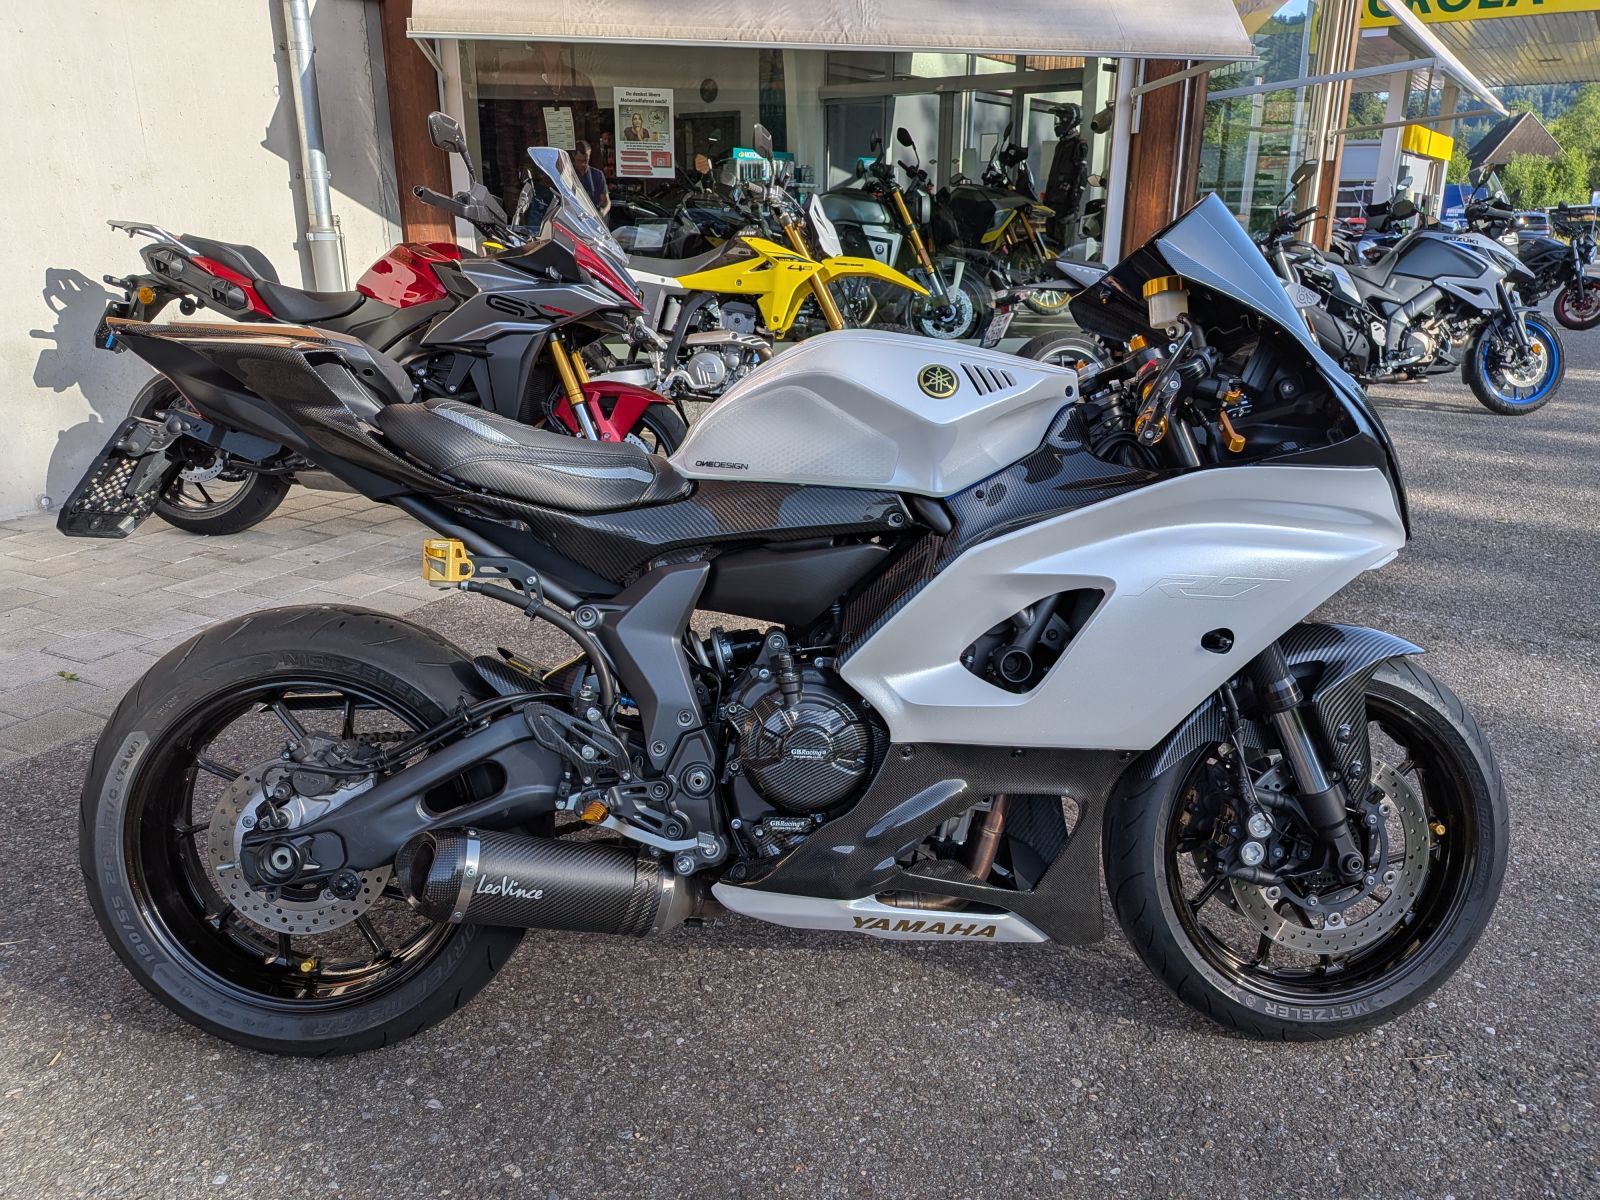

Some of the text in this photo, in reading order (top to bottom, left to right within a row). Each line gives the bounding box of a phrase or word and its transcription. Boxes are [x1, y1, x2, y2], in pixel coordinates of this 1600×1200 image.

[1443, 235, 1479, 245] SUZUKI
[695, 460, 749, 470] ONEDESIGN
[476, 874, 543, 900] LeoVince
[111, 894, 155, 963] 180/55
[853, 916, 997, 938] YAMAHA
[1264, 999, 1371, 1021] METZELER
